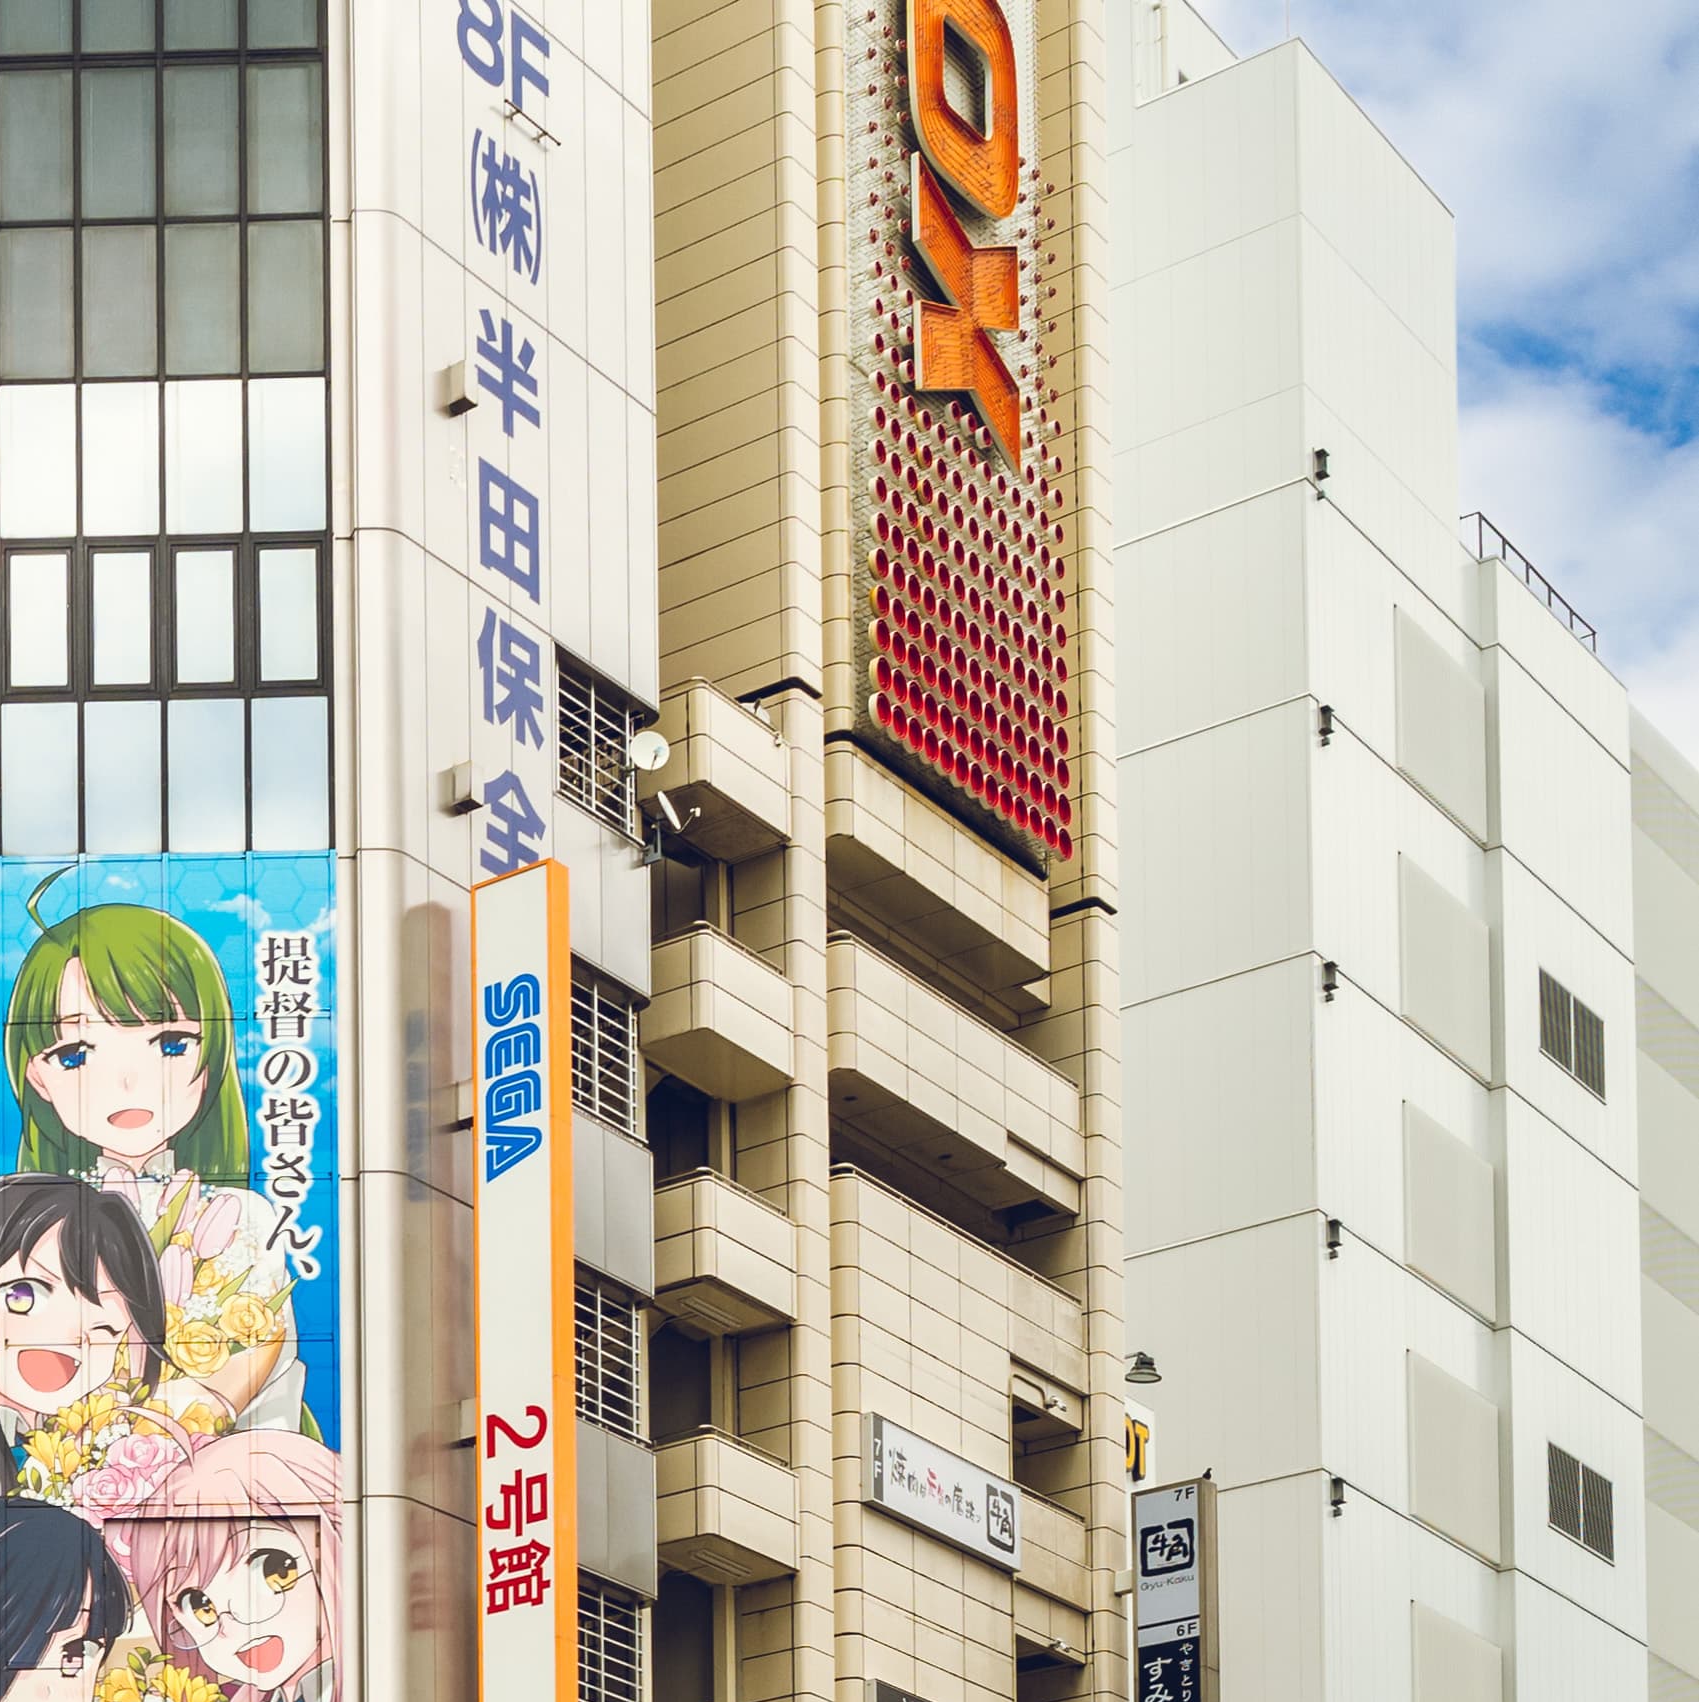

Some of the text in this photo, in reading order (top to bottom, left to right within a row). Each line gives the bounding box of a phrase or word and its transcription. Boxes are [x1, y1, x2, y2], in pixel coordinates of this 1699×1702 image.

[262, 936, 319, 1279] 提督の皆さん、
[483, 973, 541, 1183] SEGA
[485, 1404, 557, 1615] 2号館
[1148, 1535, 1189, 1561] 牛角
[1174, 1486, 1194, 1502] 7F
[1176, 1622, 1197, 1637] 6F
